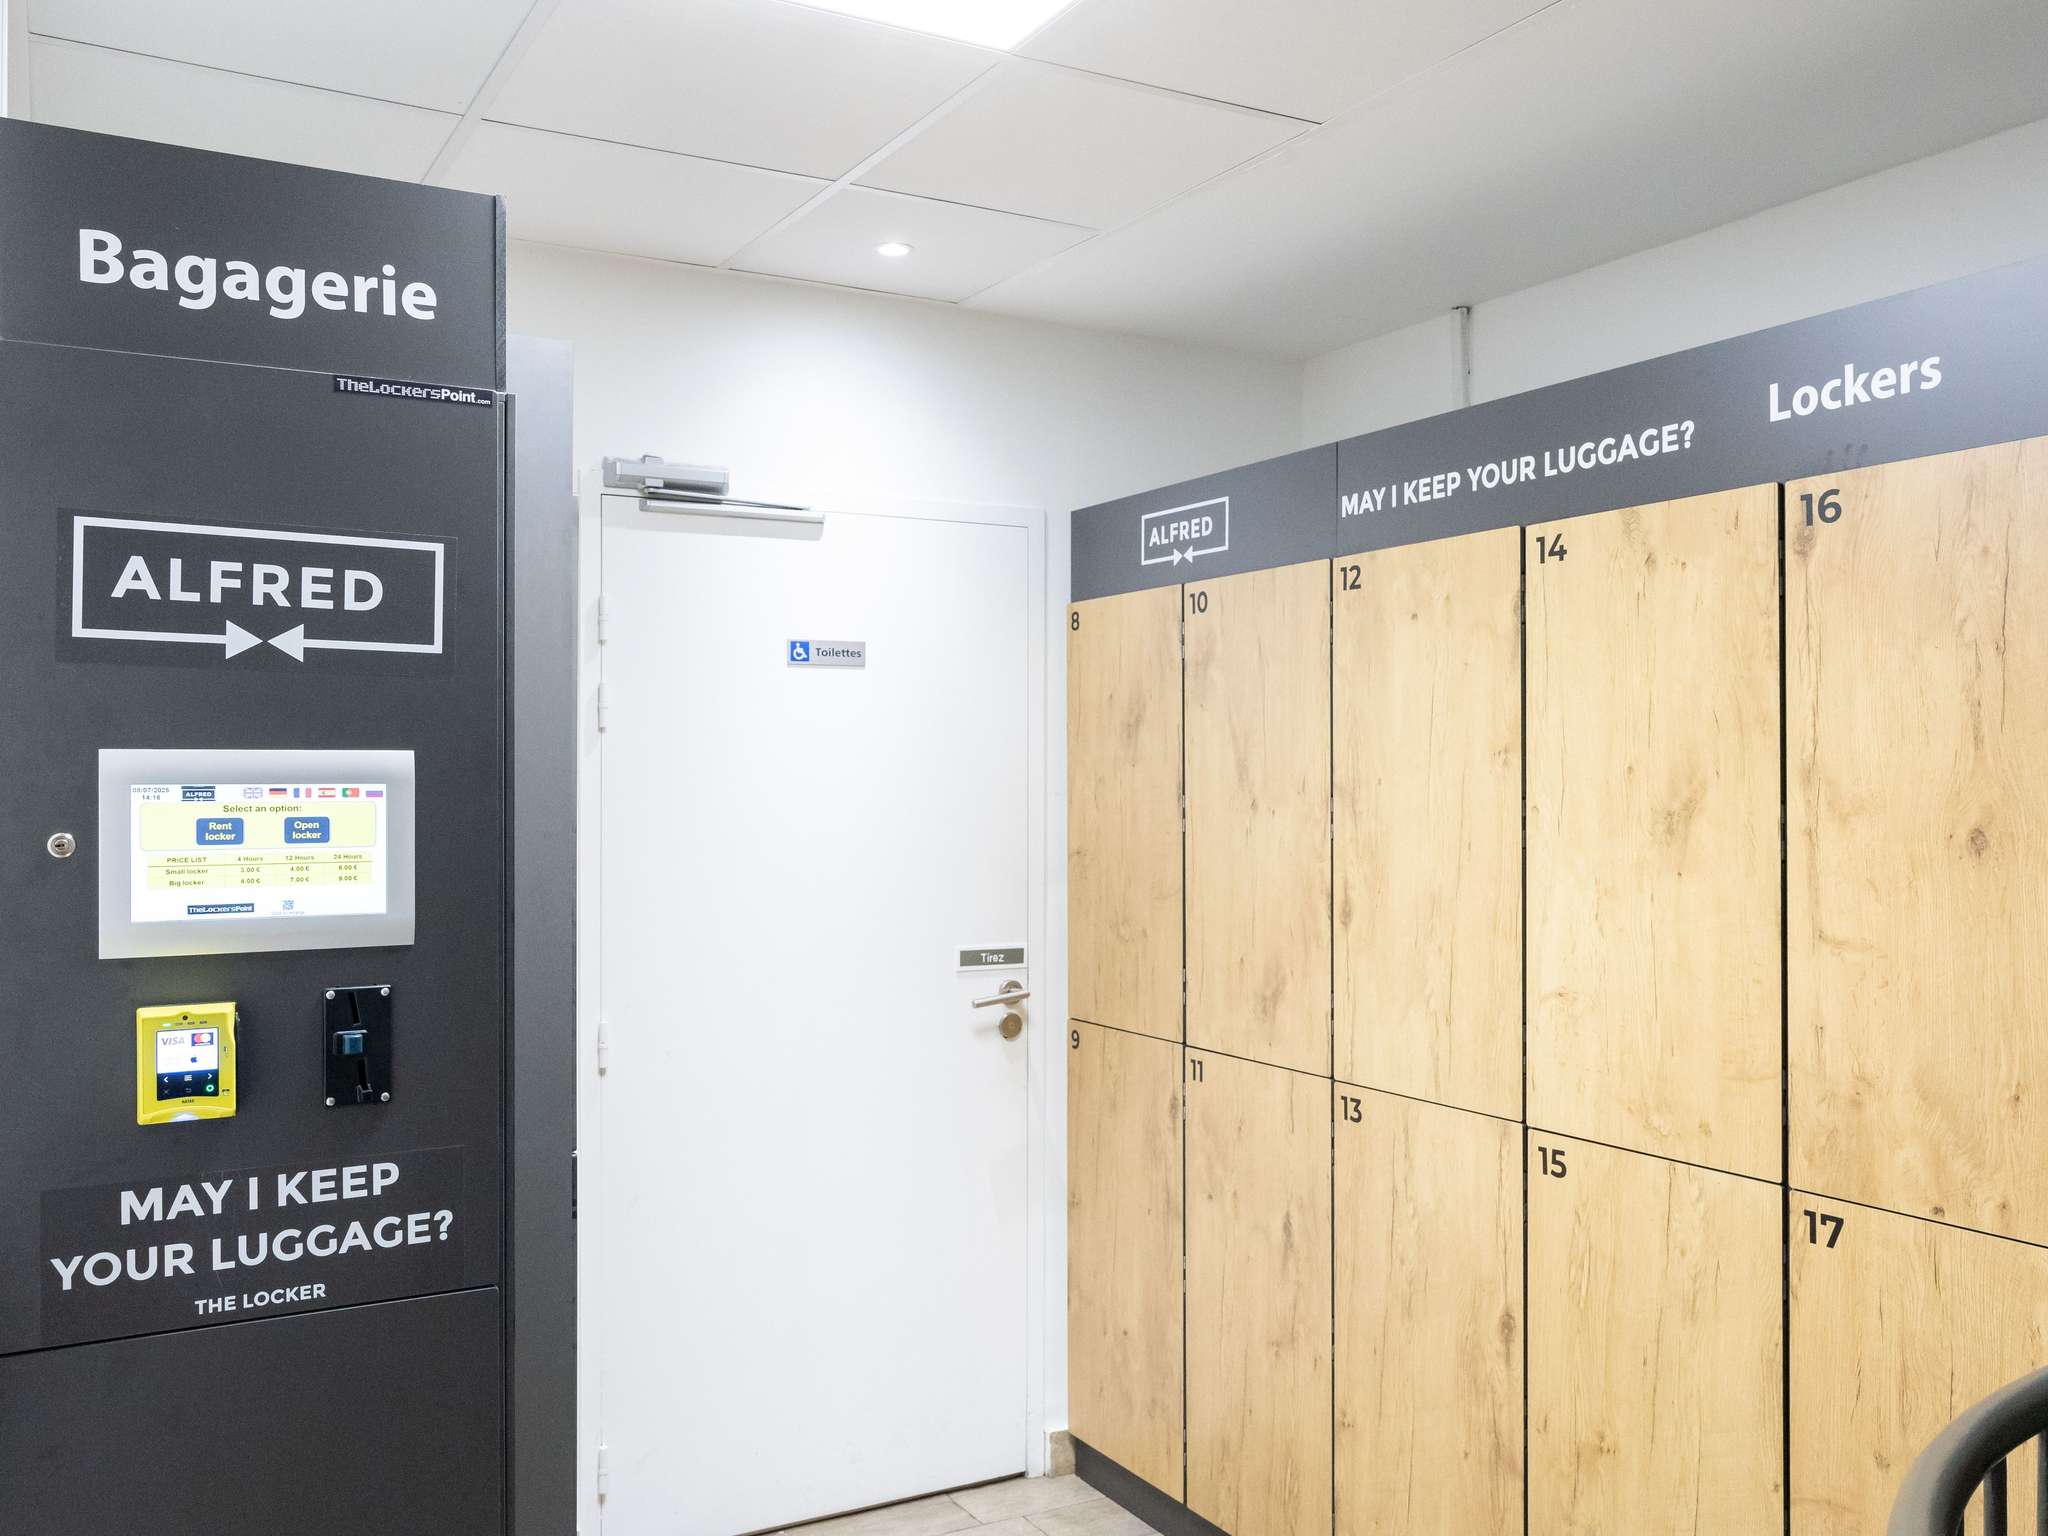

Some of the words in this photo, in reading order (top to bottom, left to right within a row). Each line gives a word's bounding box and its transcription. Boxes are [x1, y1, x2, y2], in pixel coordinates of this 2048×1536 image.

[79, 229, 437, 320] Bagagerie
[1768, 355, 1943, 423] Lockers
[1341, 487, 1386, 518] MAY
[1391, 484, 1397, 508] I
[1403, 471, 1461, 505] KEEP
[1466, 455, 1537, 492] YOUR
[1544, 419, 1695, 477] LUGGAGE?
[1800, 489, 1842, 526] 16
[1148, 516, 1215, 547] ALFRED
[1536, 533, 1568, 565] 14
[111, 555, 385, 613] ALFRED
[1340, 565, 1362, 591] 12
[1189, 591, 1208, 615] 10
[1071, 611, 1080, 632] 8
[815, 646, 863, 659] Toilettes
[223, 805, 252, 813] Select
[269, 804, 302, 814] option:
[205, 832, 236, 841] locker
[208, 821, 232, 830] Rent
[292, 831, 322, 839] locker
[294, 820, 320, 830] Open
[980, 953, 1005, 963] Tirez
[161, 1037, 186, 1046] VISA
[1071, 1029, 1080, 1050] 9
[1190, 1059, 1203, 1083] 11
[1340, 1095, 1363, 1124] 13
[1537, 1147, 1567, 1178] 15
[120, 1176, 233, 1226] MAY
[249, 1177, 259, 1211] I
[277, 1162, 400, 1207] KEEP
[1803, 1210, 1845, 1249] 17
[50, 1243, 194, 1291] YOUR
[212, 1209, 454, 1271] LUGGAGE?
[195, 1296, 237, 1315] THE
[243, 1283, 327, 1310] LOCKER
